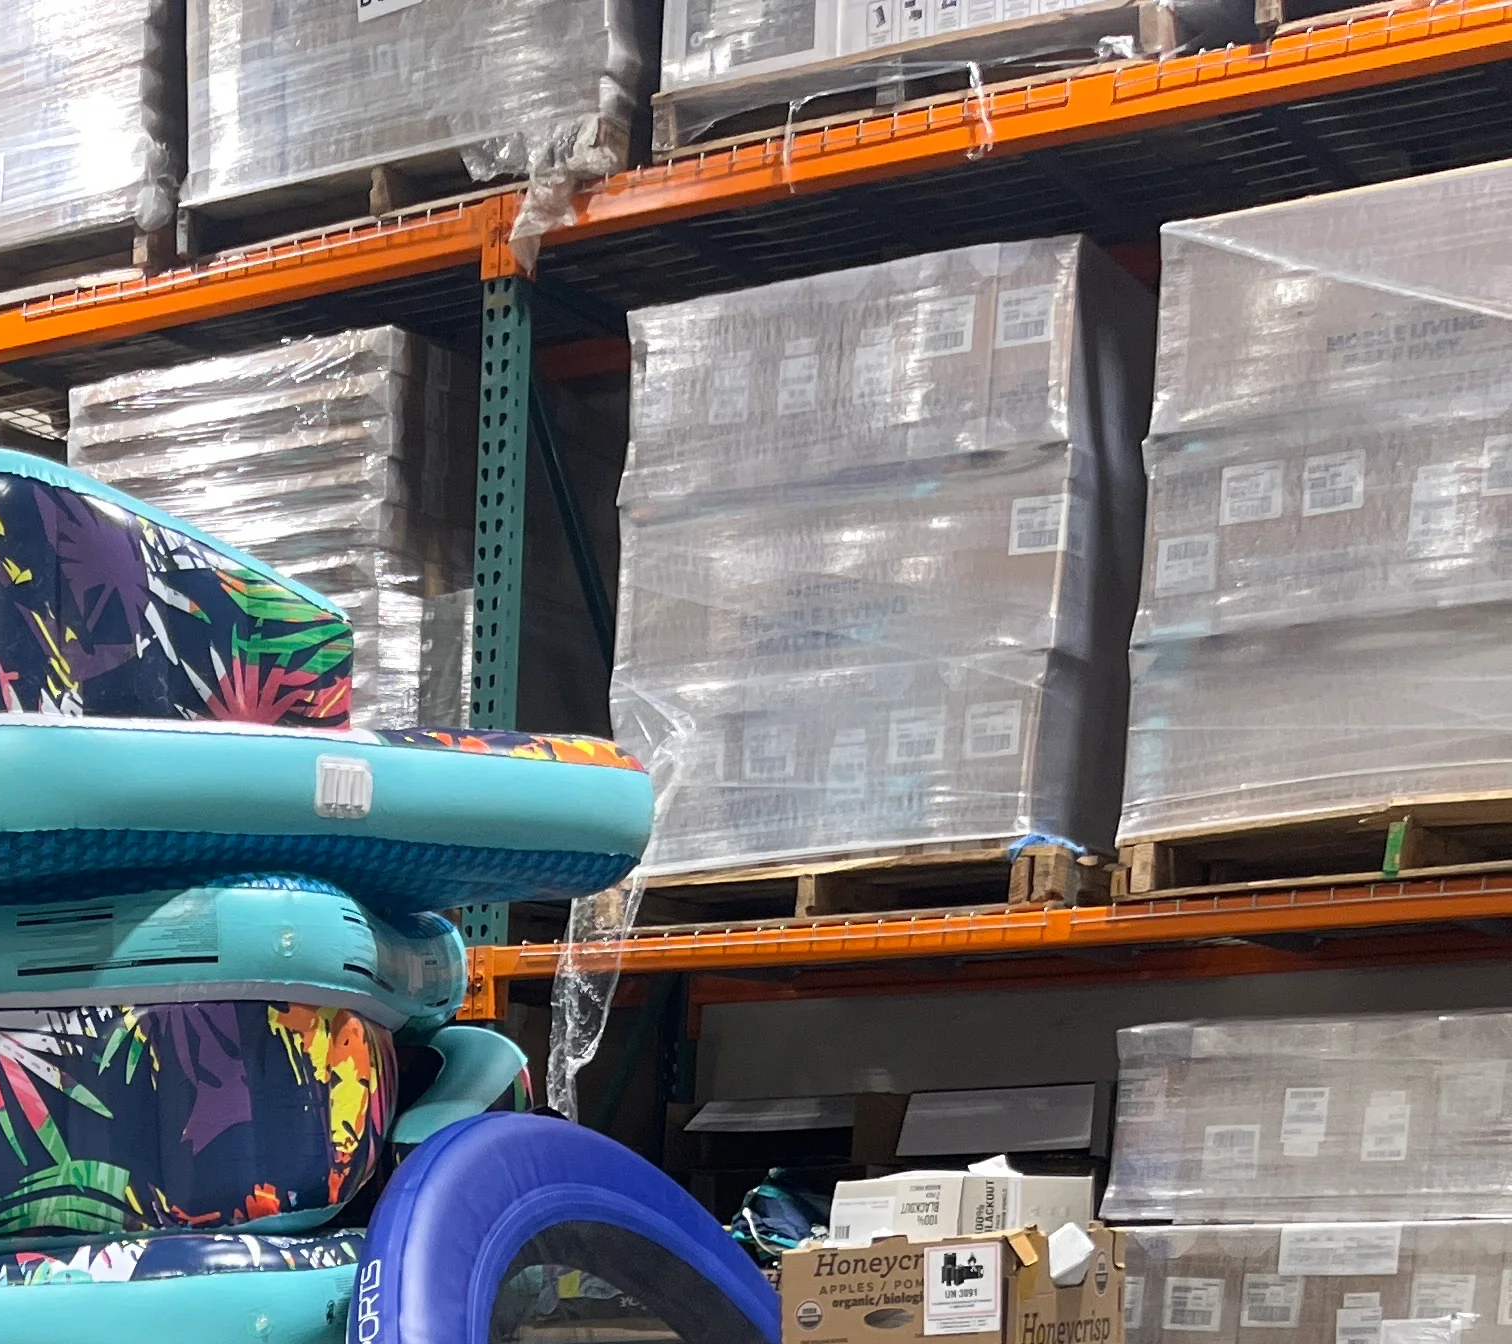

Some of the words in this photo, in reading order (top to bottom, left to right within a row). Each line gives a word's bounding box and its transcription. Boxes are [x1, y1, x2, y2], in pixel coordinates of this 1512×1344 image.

[813, 1252, 924, 1279] Honeycr
[819, 1281, 874, 1295] APPLES
[894, 1279, 924, 1291] POM
[944, 1289, 956, 1298] UN
[832, 1291, 924, 1310] organic/biologi
